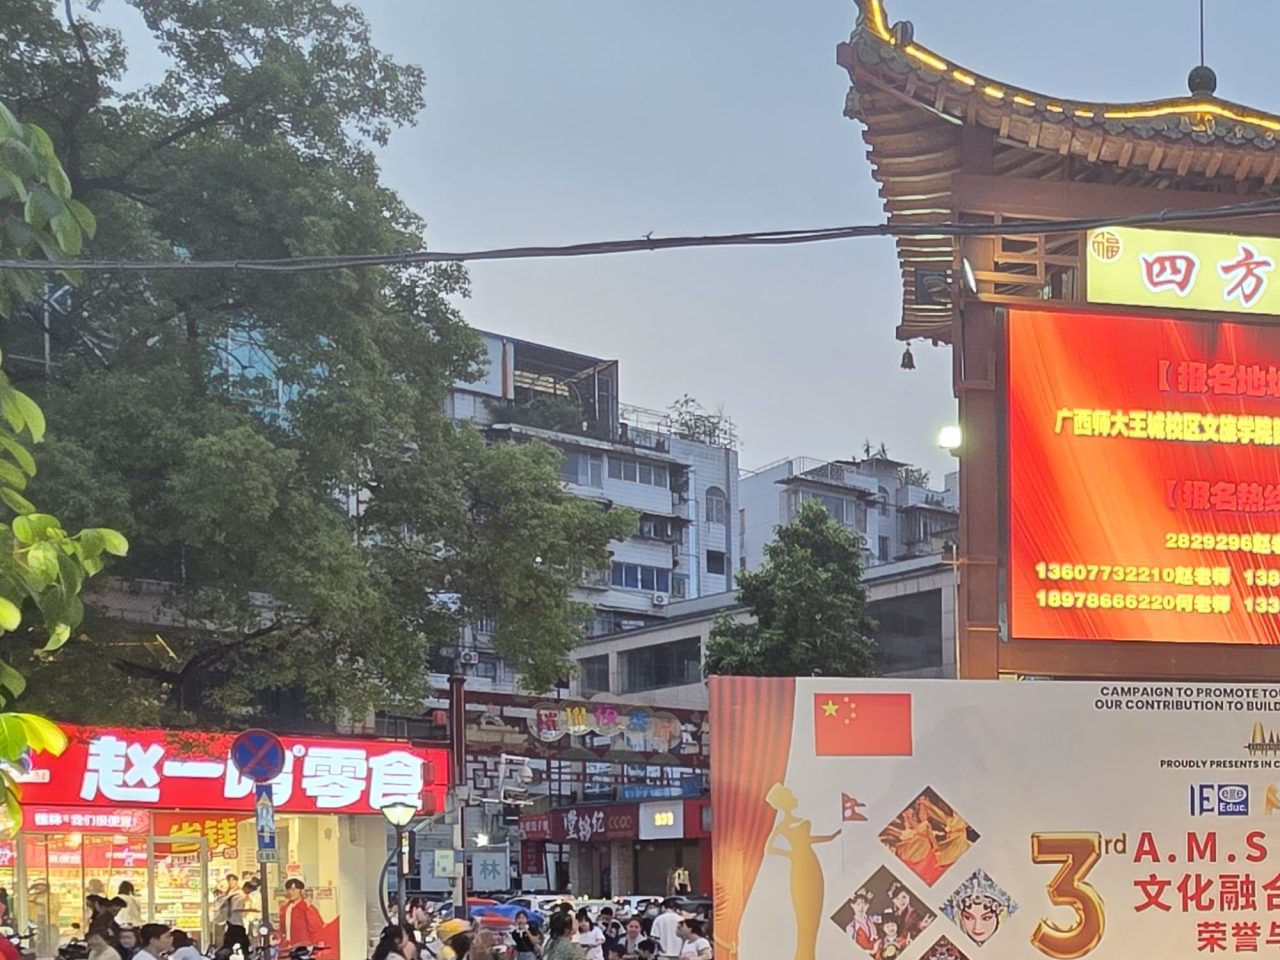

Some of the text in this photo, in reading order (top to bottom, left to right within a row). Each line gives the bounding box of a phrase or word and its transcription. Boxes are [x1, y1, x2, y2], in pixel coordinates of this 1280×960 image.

[1100, 686, 1174, 699] CAMPAIGN
[1175, 687, 1194, 698] TO
[1196, 688, 1260, 699] PROMOTE
[1095, 699, 1123, 710] OUR
[1125, 699, 1224, 711] CONTRIBUTION
[1226, 700, 1244, 711] TO
[1160, 759, 1208, 770] PROUDLY
[1209, 759, 1259, 770] PRESENTS
[1261, 760, 1272, 769] IN
[1219, 802, 1248, 813] Educ.
[1133, 829, 1267, 864] A.M.S
